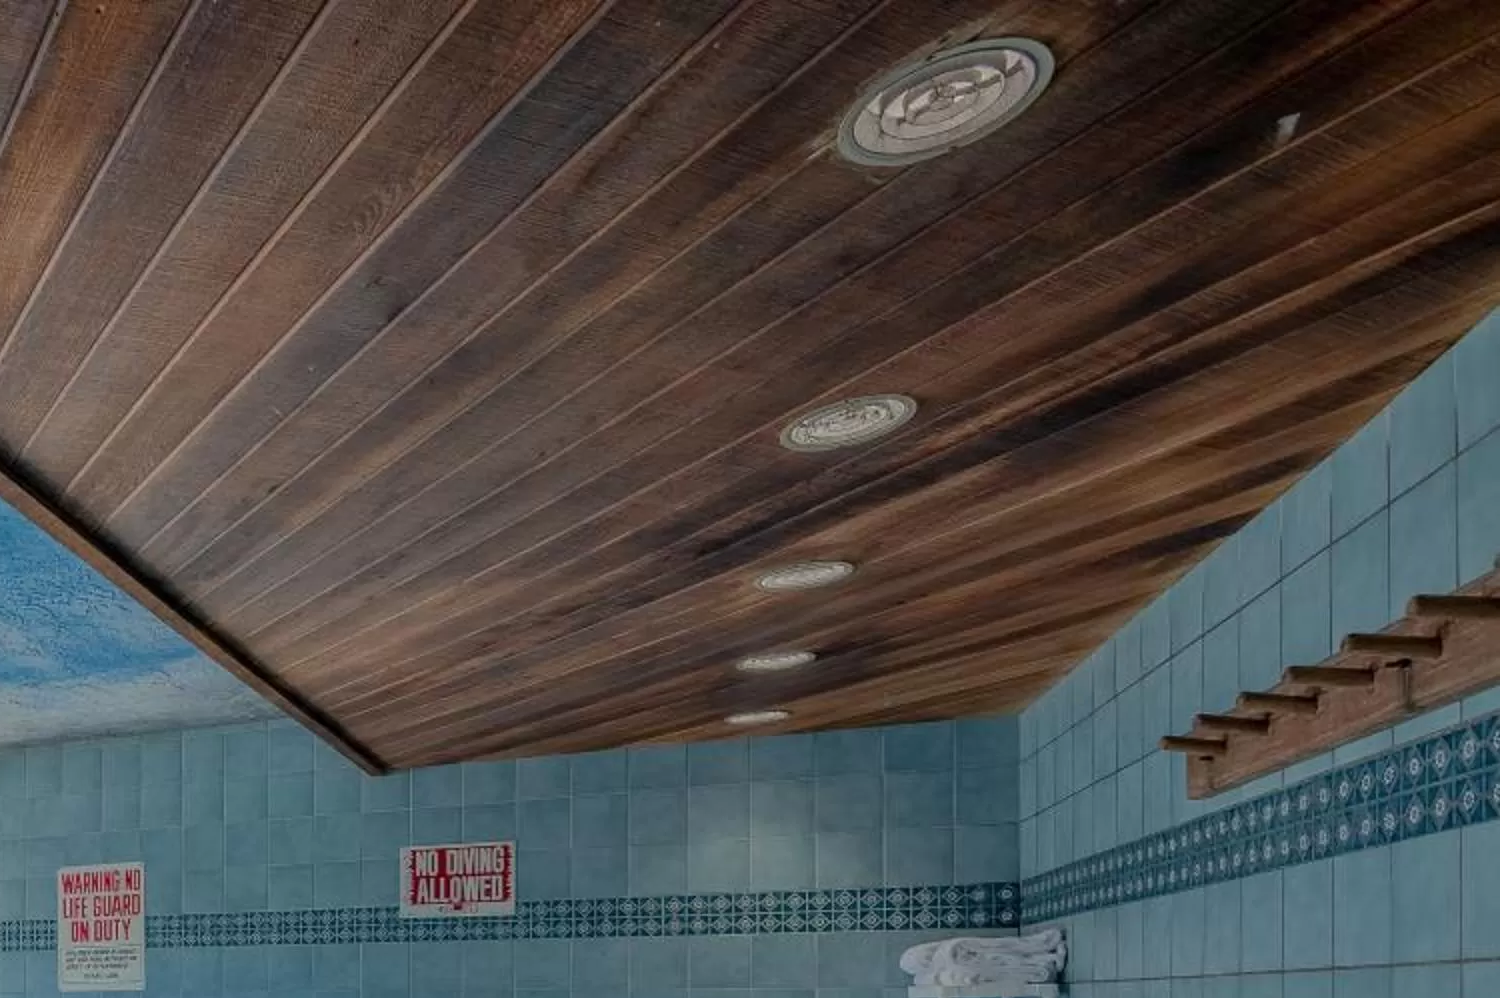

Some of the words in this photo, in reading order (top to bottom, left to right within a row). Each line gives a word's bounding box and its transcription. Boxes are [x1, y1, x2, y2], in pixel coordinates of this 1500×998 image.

[415, 850, 438, 877] NO
[445, 846, 504, 875] DIVING
[61, 870, 121, 894] WARNING
[125, 868, 141, 891] NO
[417, 876, 503, 903] ALLOWED
[63, 897, 88, 919] LIFE
[93, 894, 141, 917] GUARD
[71, 920, 89, 943] ON
[93, 918, 131, 941] DUTY
